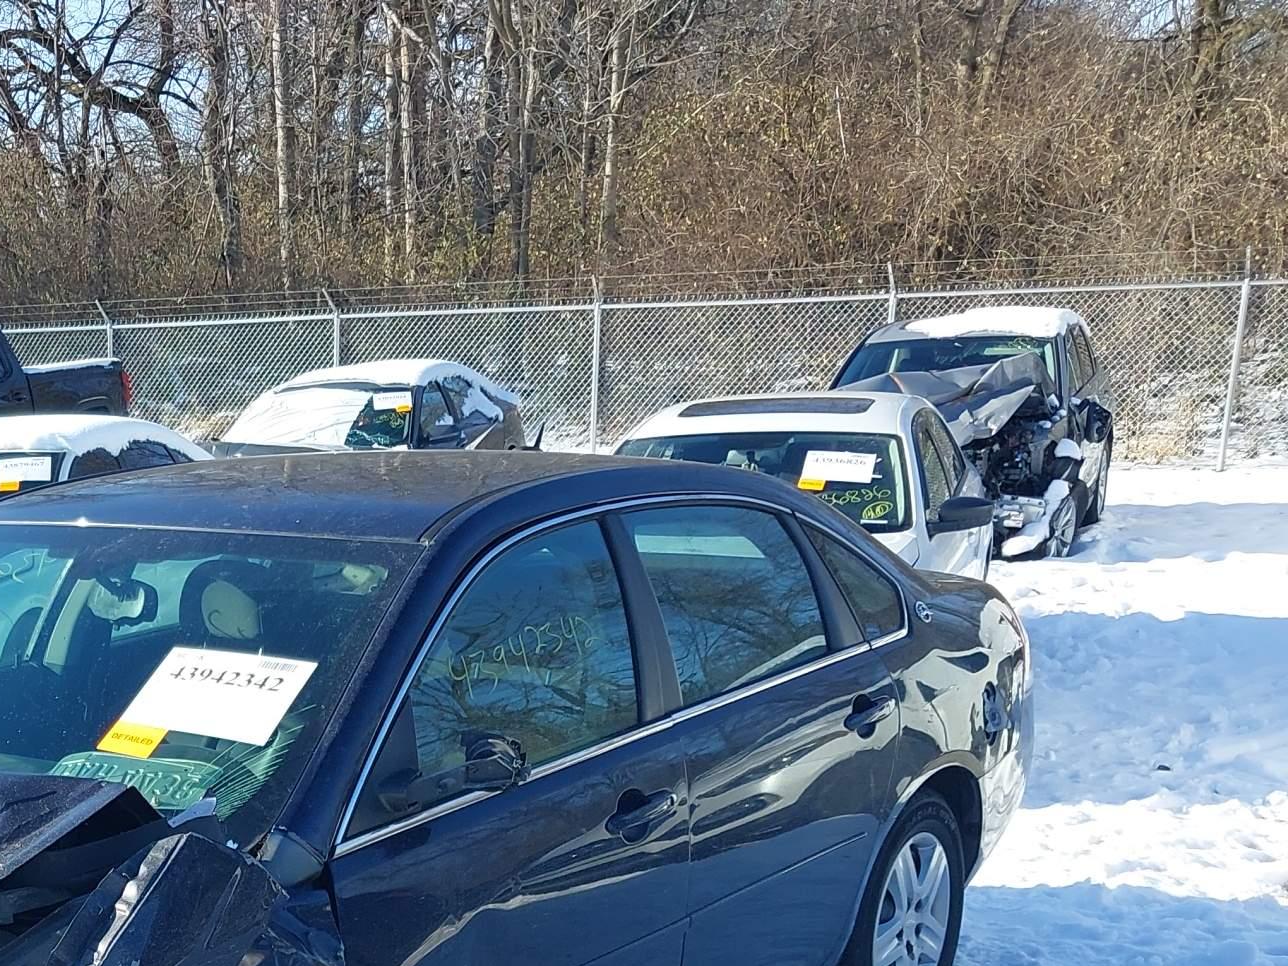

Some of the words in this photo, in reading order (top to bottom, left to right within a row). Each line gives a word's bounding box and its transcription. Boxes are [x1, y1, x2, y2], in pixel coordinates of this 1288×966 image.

[448, 615, 609, 700] 43942342
[169, 665, 286, 692] 43942342
[111, 732, 153, 746] DETAILED
